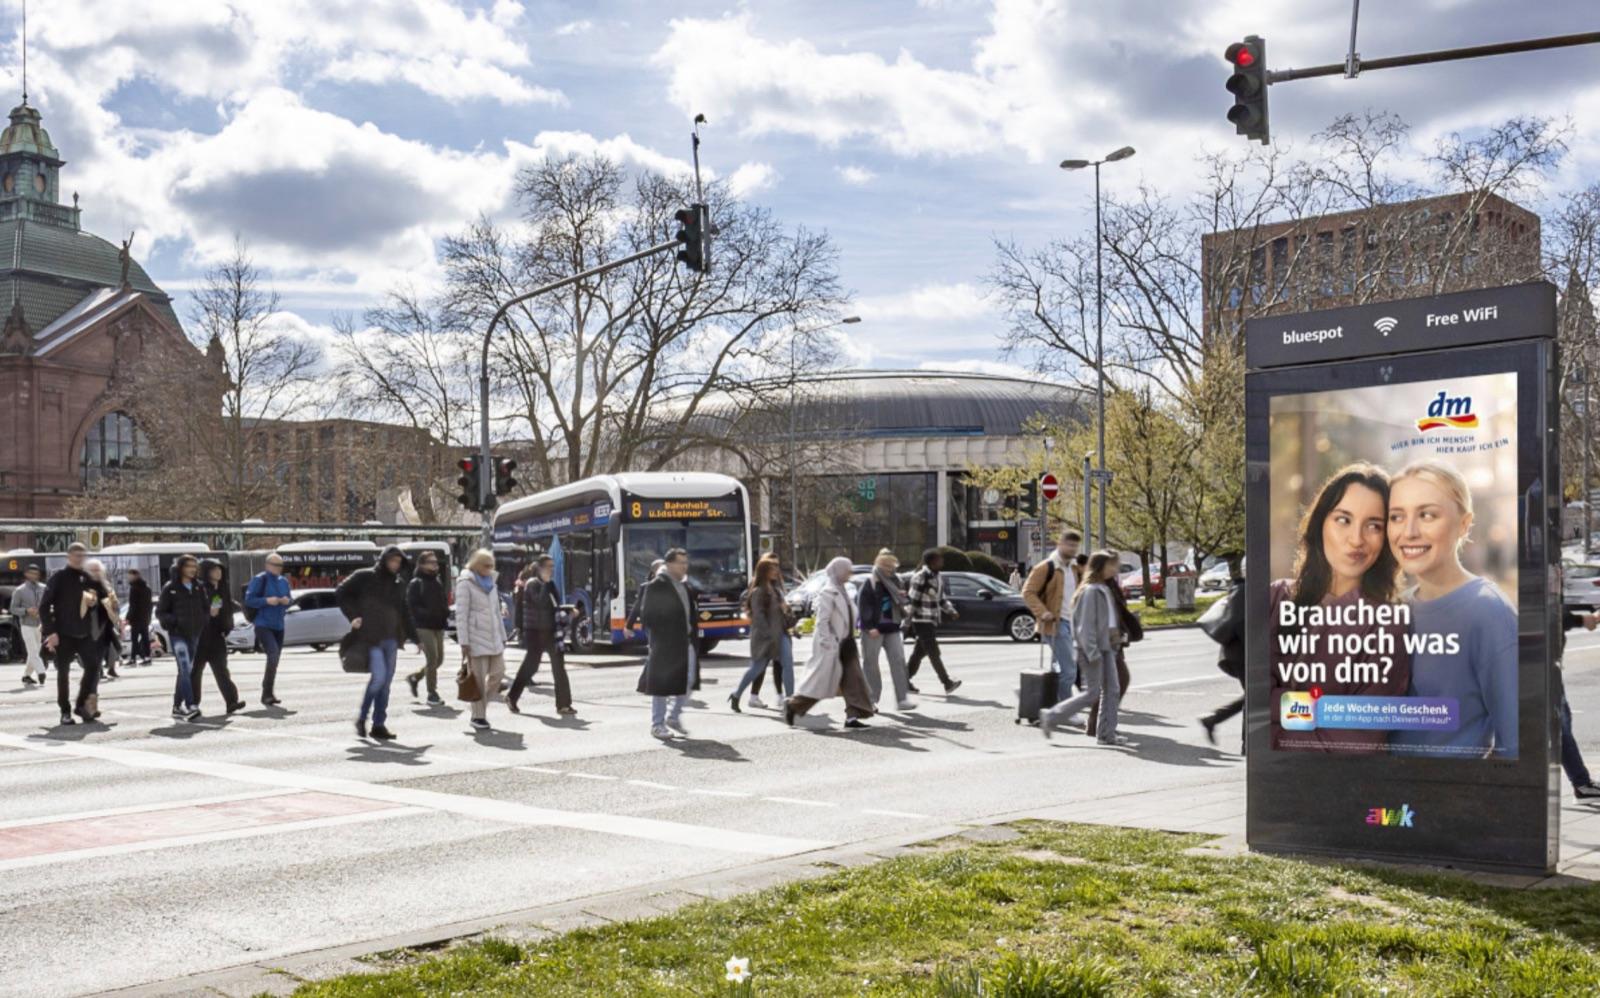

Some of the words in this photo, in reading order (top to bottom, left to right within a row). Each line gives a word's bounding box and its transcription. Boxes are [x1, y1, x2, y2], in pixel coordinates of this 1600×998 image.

[1426, 312, 1459, 328] Free
[1463, 306, 1499, 323] WiFi
[1282, 325, 1344, 345] bluespot
[1427, 391, 1473, 417] dm
[1391, 440, 1409, 451] HIER
[1411, 437, 1425, 446] BIN
[1427, 436, 1441, 444] ICH
[1443, 435, 1475, 444] MENSCH
[1436, 446, 1454, 454] HIER
[1495, 438, 1509, 448] EIN
[632, 502, 642, 518] 8
[664, 501, 709, 510] Bahnholz
[706, 509, 726, 517] Str.
[1279, 598, 1411, 627] Brauchen
[1278, 627, 1319, 655] wir
[1327, 628, 1395, 656] noch
[1403, 633, 1460, 656] was
[1278, 662, 1326, 684] von
[1334, 657, 1393, 684] dm?
[1290, 701, 1309, 714] dm
[1323, 703, 1345, 713] Jede
[1346, 703, 1379, 713] Woche
[1382, 704, 1397, 714] ein
[1400, 704, 1449, 715] Geschenk
[1331, 714, 1343, 722] der
[1373, 714, 1391, 723] nach
[1392, 715, 1420, 723] Deinem
[1365, 804, 1416, 828] awk
